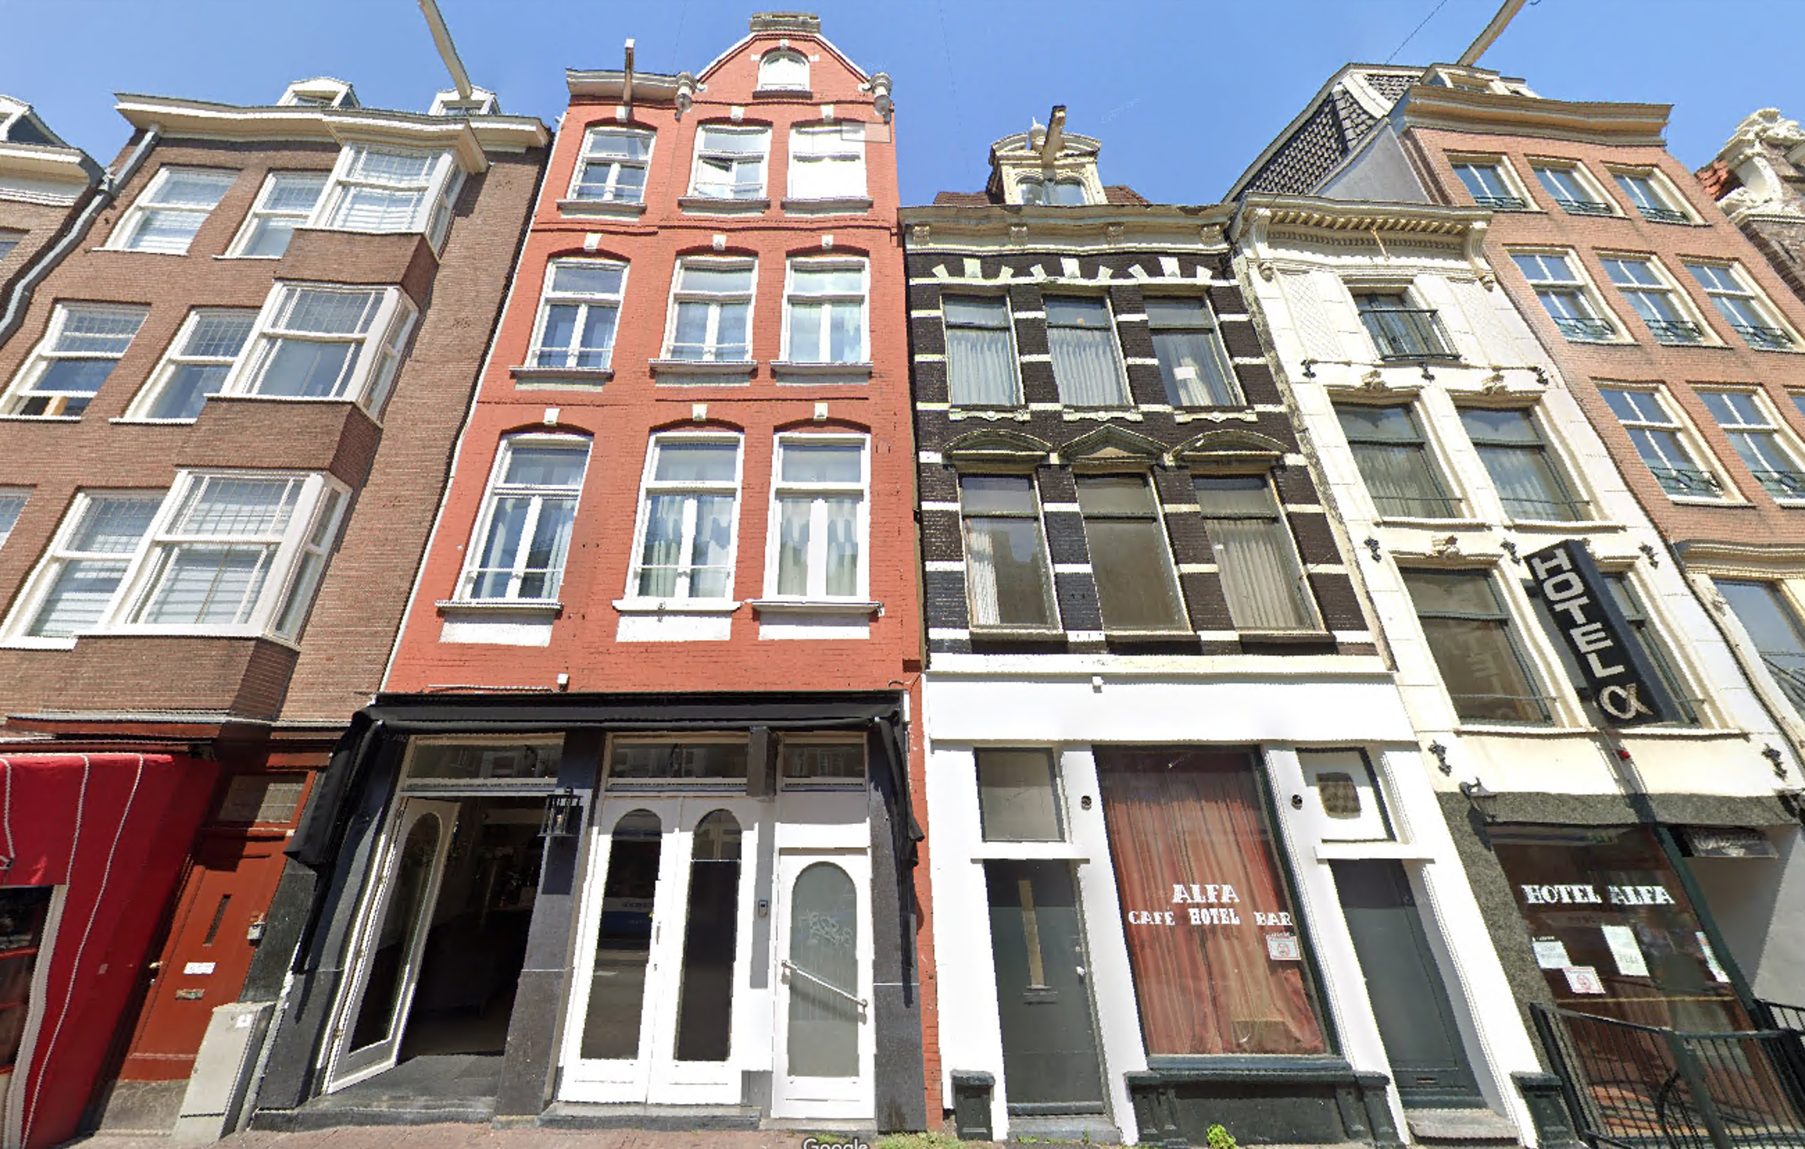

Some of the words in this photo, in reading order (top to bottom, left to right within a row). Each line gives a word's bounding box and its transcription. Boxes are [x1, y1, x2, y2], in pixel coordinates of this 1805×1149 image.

[1531, 548, 1625, 678] HOTEL
[1172, 884, 1240, 903] ALFA
[1521, 884, 1602, 904] HOTEL
[1608, 885, 1675, 905] ALFA
[1187, 908, 1241, 925] HOTEL
[1253, 911, 1293, 926] BAR
